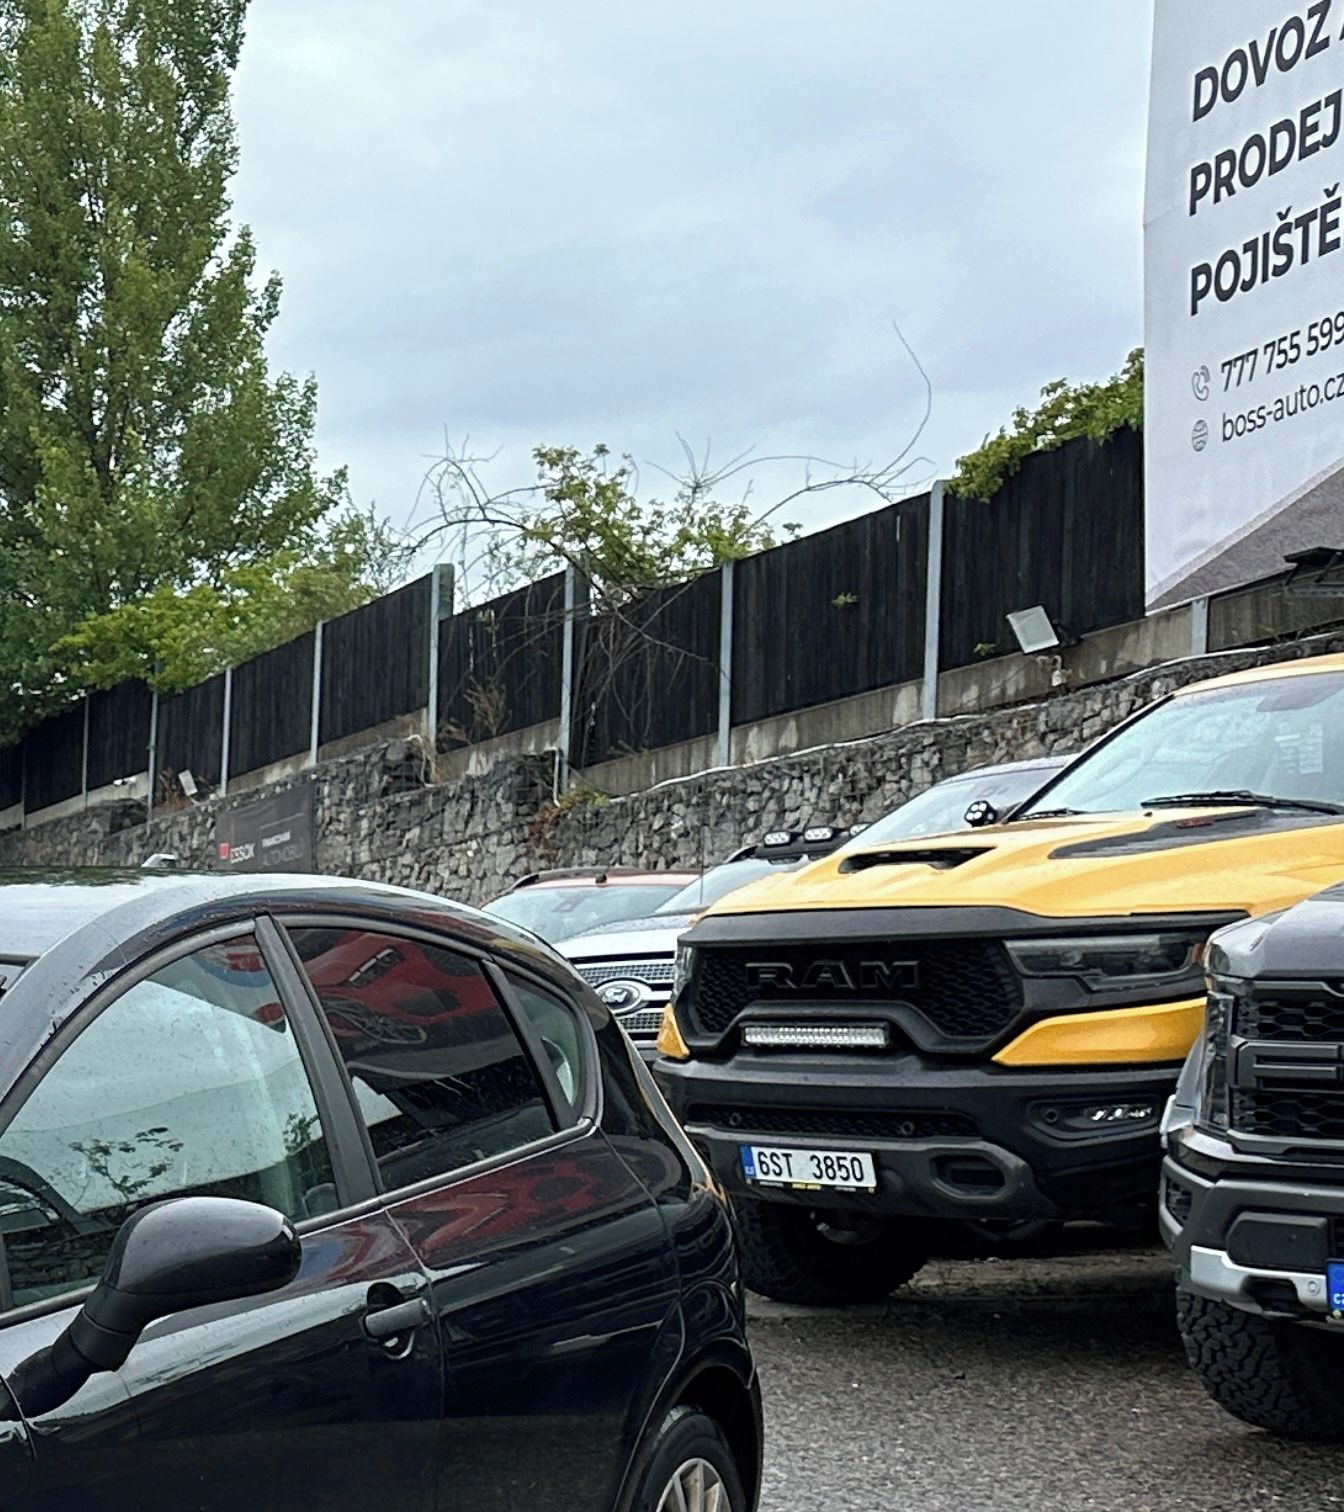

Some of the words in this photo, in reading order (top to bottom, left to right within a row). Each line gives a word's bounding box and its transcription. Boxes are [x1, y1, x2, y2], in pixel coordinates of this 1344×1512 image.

[1192, 0, 1332, 122] DOVOZ
[1189, 88, 1343, 217] PRODEJ
[1221, 348, 1259, 392] 777
[1263, 330, 1301, 374] 755
[1306, 311, 1344, 356] 599
[1222, 372, 1344, 442] boss-auto.cz
[745, 960, 920, 990] RAM
[757, 1151, 793, 1178] 6ST
[810, 1154, 864, 1182] 3850
